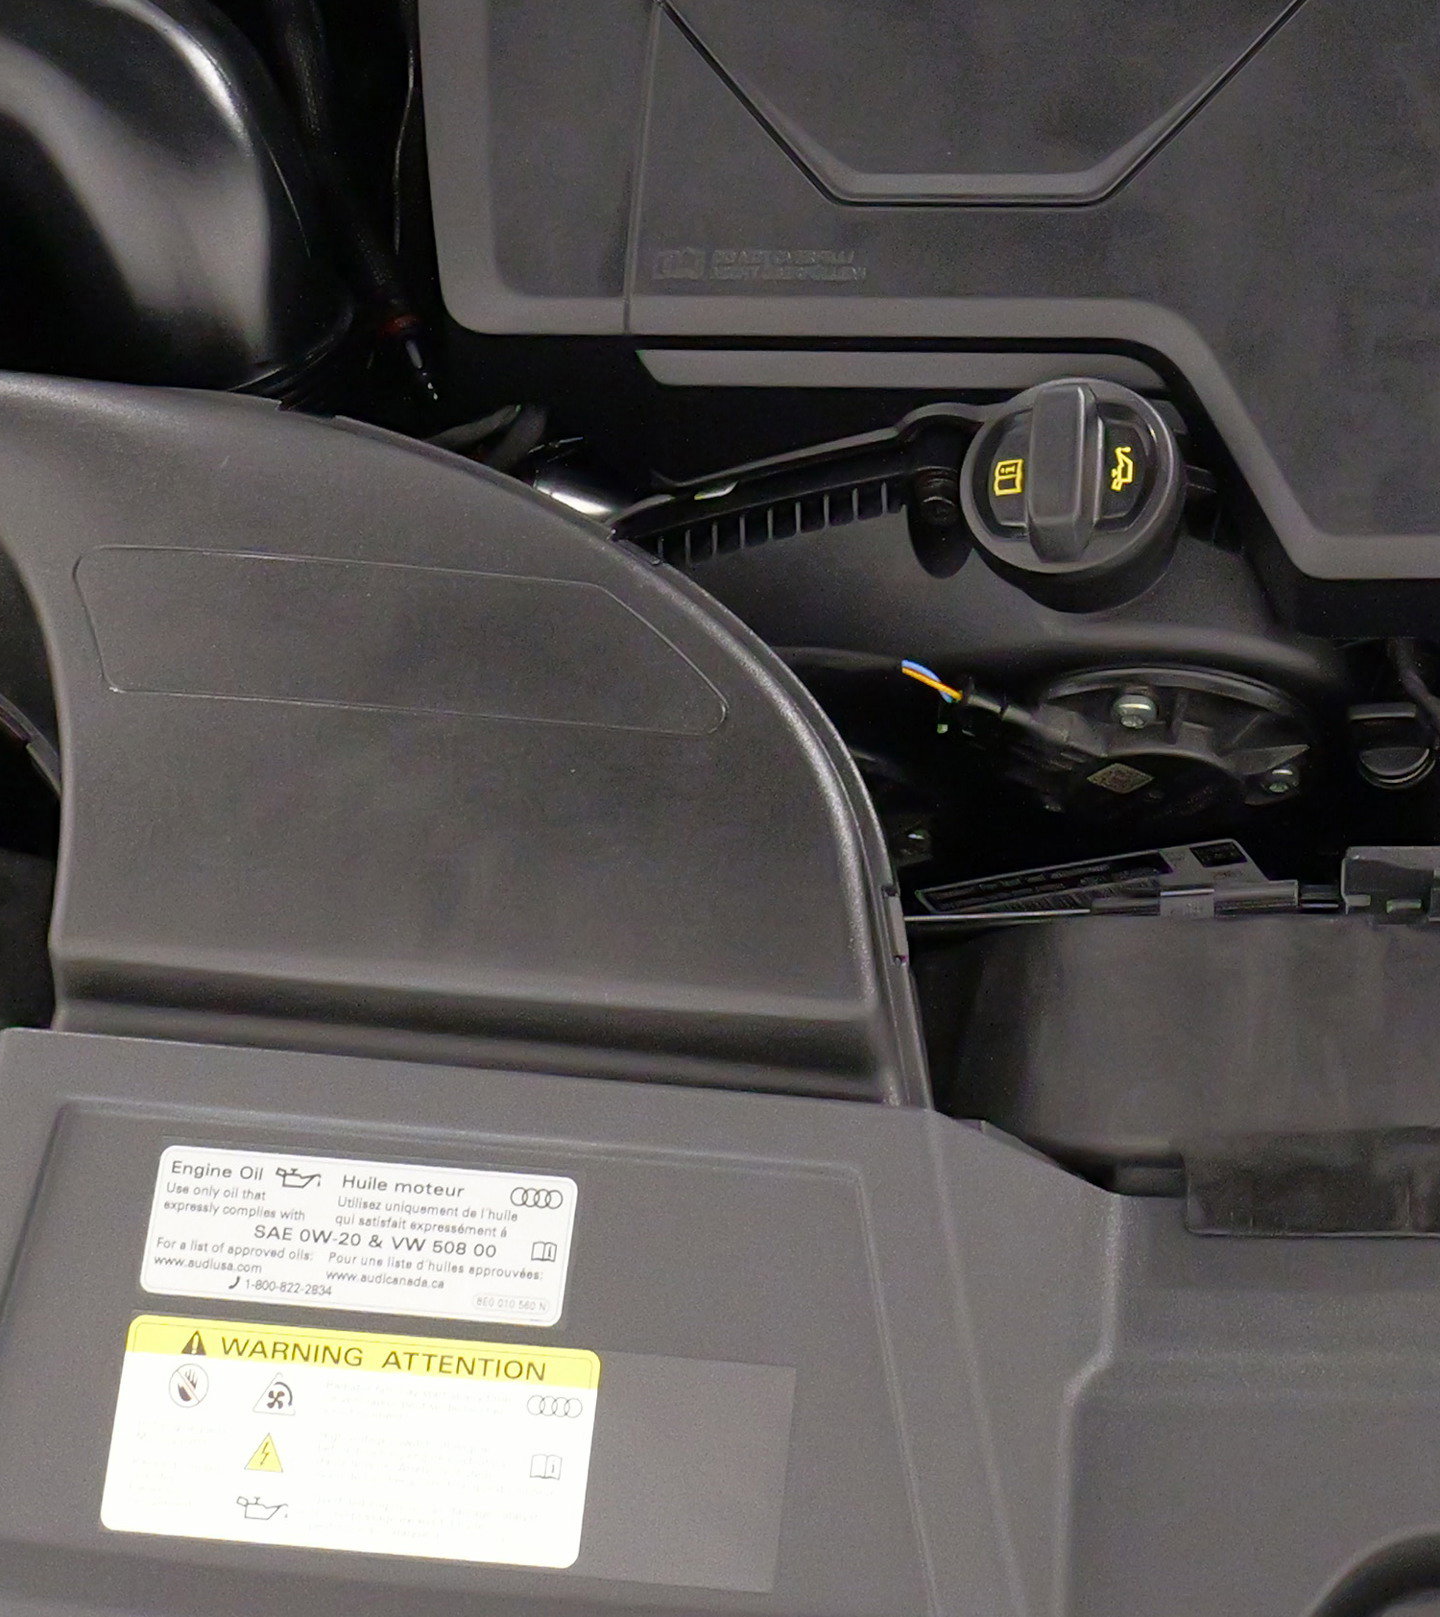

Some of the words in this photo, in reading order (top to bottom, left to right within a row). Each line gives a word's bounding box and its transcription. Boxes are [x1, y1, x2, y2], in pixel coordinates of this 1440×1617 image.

[171, 1160, 232, 1179] Engine
[240, 1166, 263, 1180] Oil
[166, 1182, 189, 1194] Use
[193, 1186, 220, 1199] only
[223, 1187, 238, 1198] oil
[242, 1188, 266, 1201] that
[342, 1175, 388, 1191] Huile
[395, 1182, 465, 1197] moteur
[164, 1201, 220, 1215] expressly
[222, 1204, 276, 1218] complies
[280, 1209, 305, 1221] with
[337, 1196, 381, 1211] Utilisez
[385, 1202, 458, 1218] uniquement
[462, 1205, 477, 1218] de
[335, 1214, 355, 1226] qui
[359, 1217, 406, 1229] satisfait
[410, 1220, 496, 1238] expressément
[157, 1237, 175, 1249] For
[180, 1241, 186, 1250] a
[190, 1240, 208, 1252] list
[212, 1242, 226, 1253] of
[227, 1245, 284, 1259] approved
[254, 1225, 293, 1240] SAE
[299, 1228, 361, 1247] 0W-20
[368, 1235, 383, 1248] &
[392, 1236, 426, 1252] VW
[432, 1240, 466, 1255] 508
[473, 1244, 497, 1258] 00
[328, 1251, 357, 1265] Pour
[361, 1256, 383, 1267] une
[387, 1257, 412, 1269] liste
[245, 1279, 332, 1296] 1-800-822-2834
[220, 1336, 364, 1367] WARNING
[381, 1351, 547, 1382] ATTENTION
